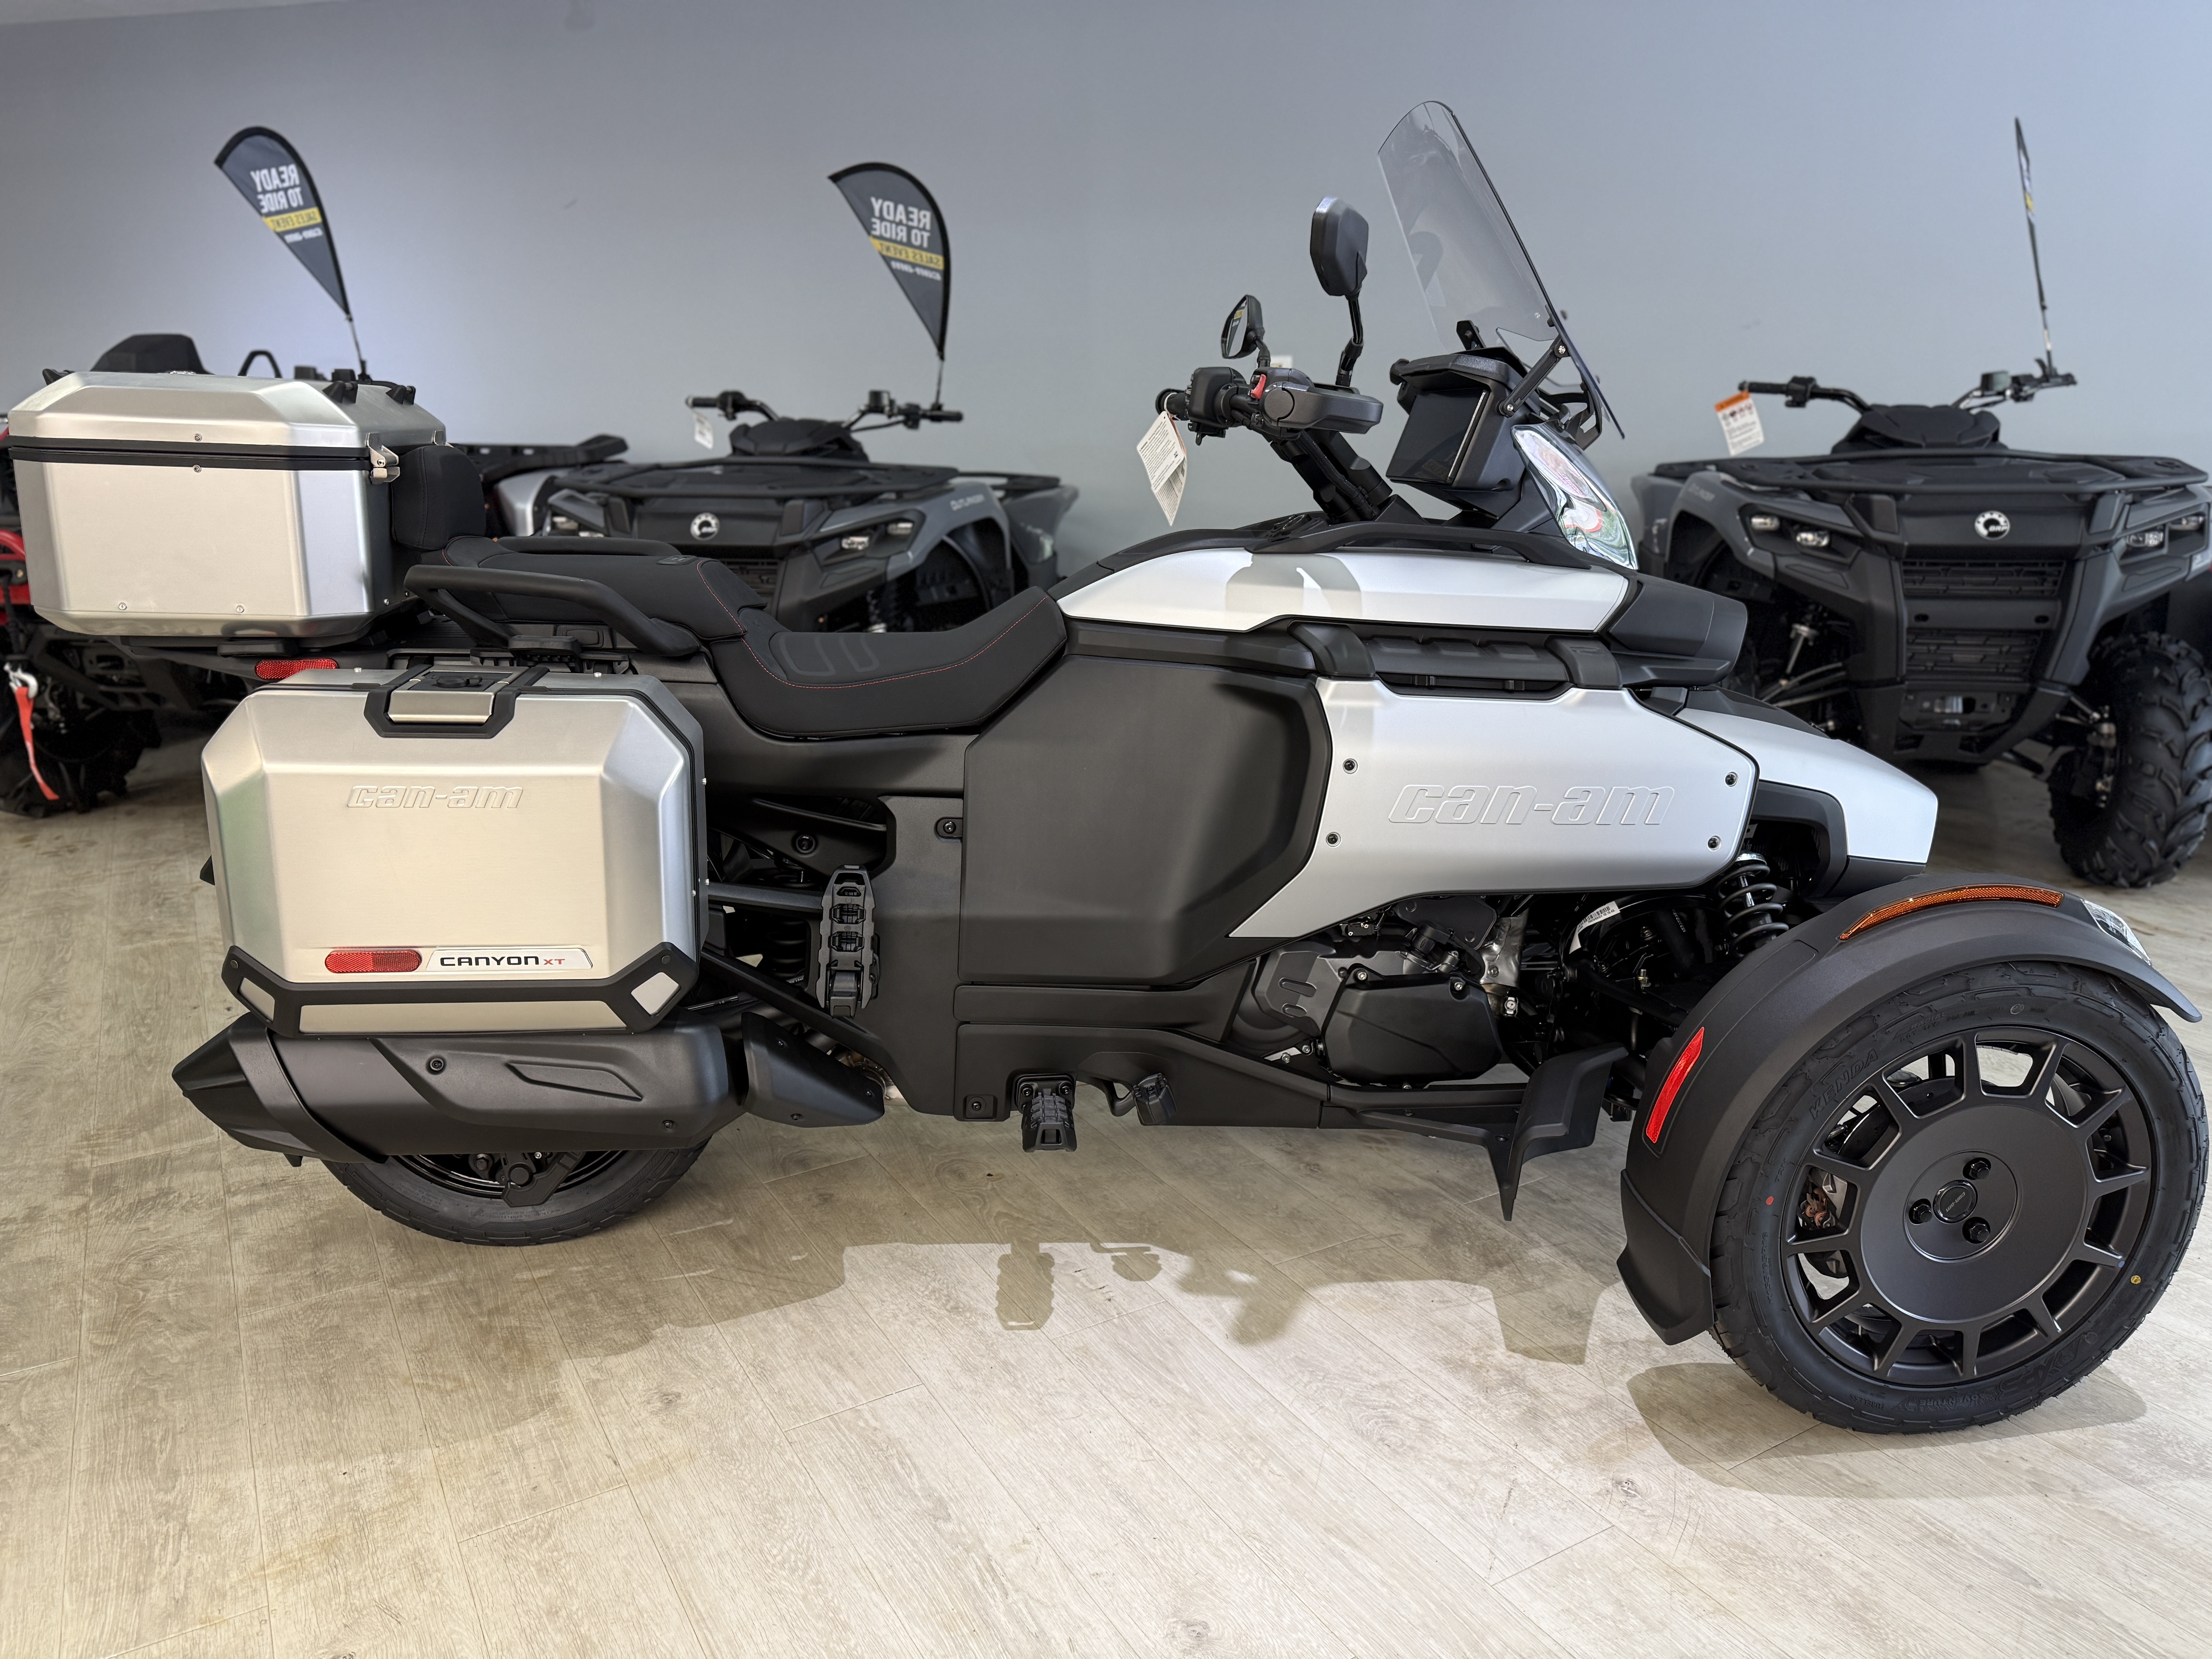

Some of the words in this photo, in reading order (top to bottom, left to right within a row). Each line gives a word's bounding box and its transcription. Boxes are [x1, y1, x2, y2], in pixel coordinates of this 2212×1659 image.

[347, 786, 523, 808] can-am
[1388, 784, 1675, 825] can-am
[440, 956, 539, 967] CANYON
[1809, 1049, 1878, 1120] KENDA
[1850, 1394, 1885, 1410] TUBELESS
